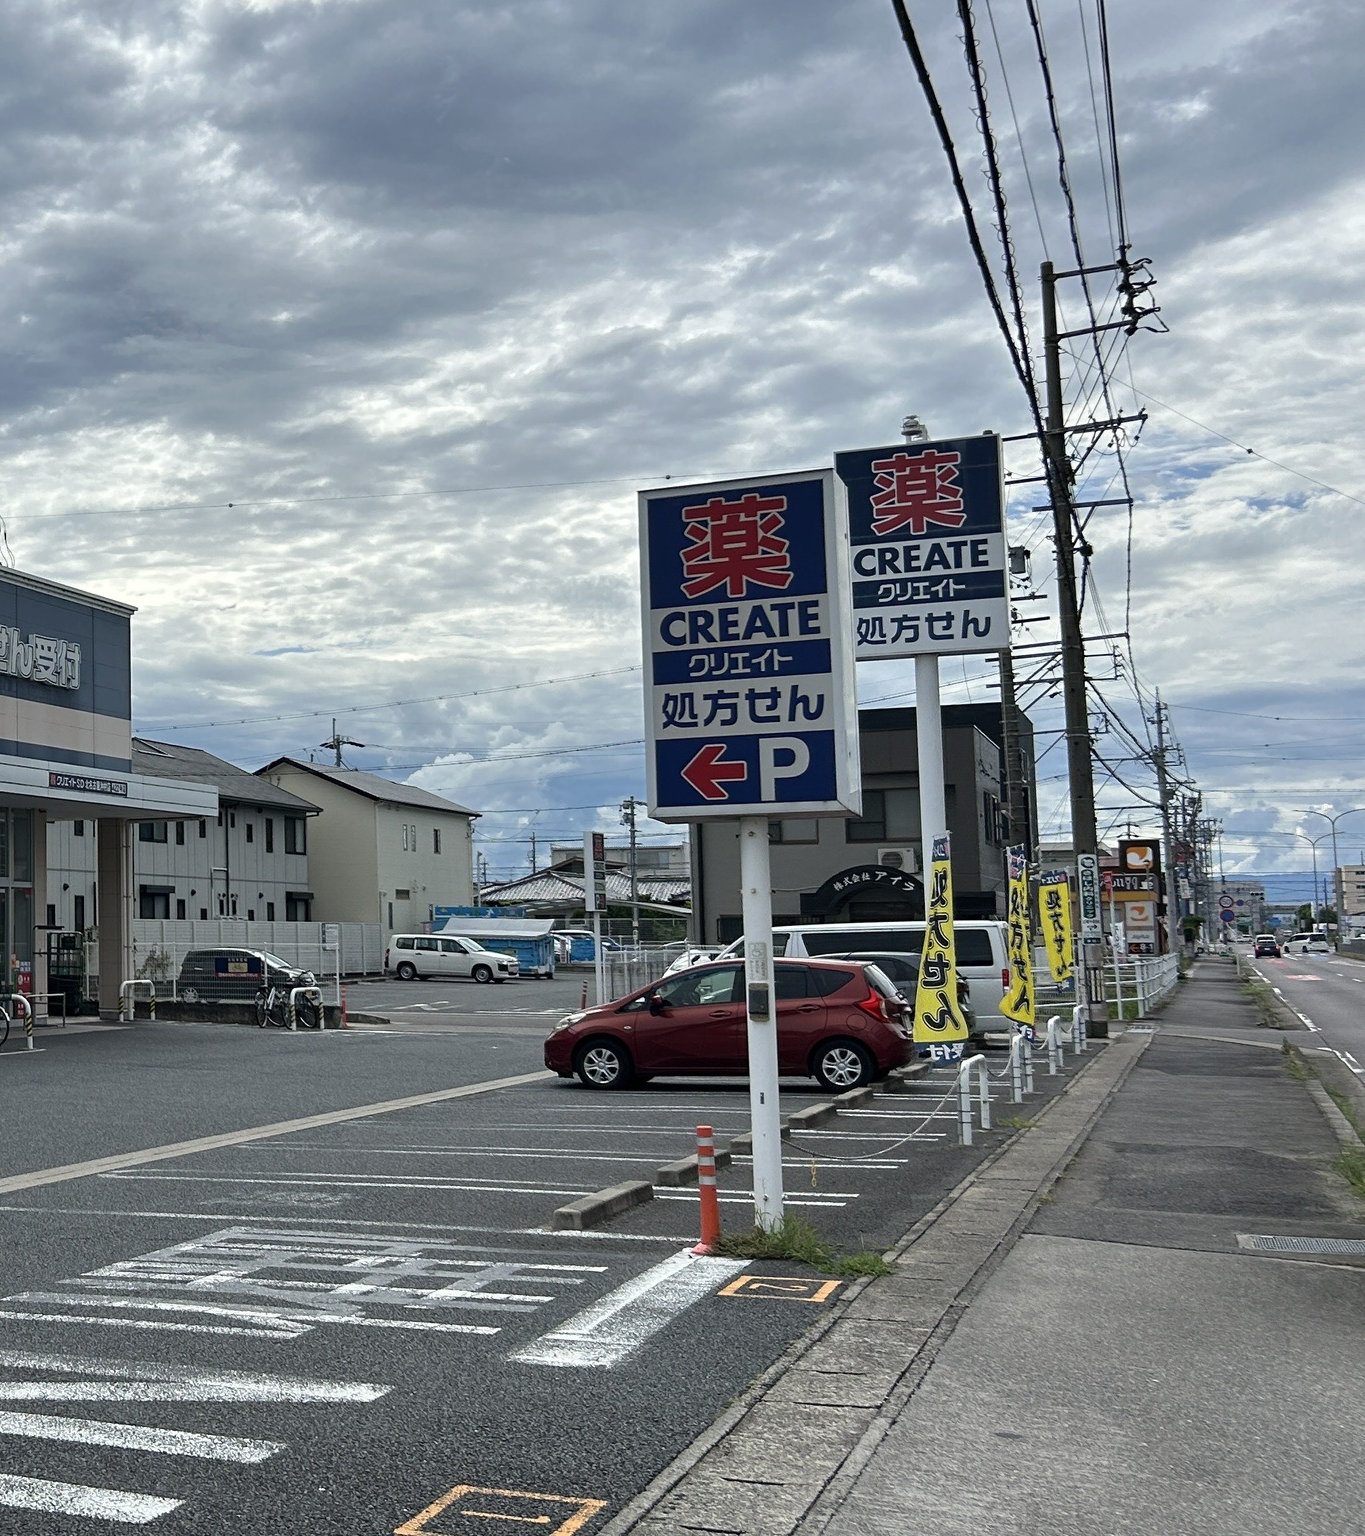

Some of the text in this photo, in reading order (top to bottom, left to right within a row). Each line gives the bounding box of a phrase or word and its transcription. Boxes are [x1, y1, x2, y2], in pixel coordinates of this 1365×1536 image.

[871, 449, 967, 536] 薬
[680, 494, 794, 599] 薬
[853, 538, 990, 577] CREATE
[878, 578, 966, 603] クリエイト
[660, 600, 822, 647] CREATE
[856, 609, 991, 647] 処方せん
[689, 649, 793, 678] クリエイト
[662, 685, 825, 730] 処方せん
[759, 737, 811, 801] P
